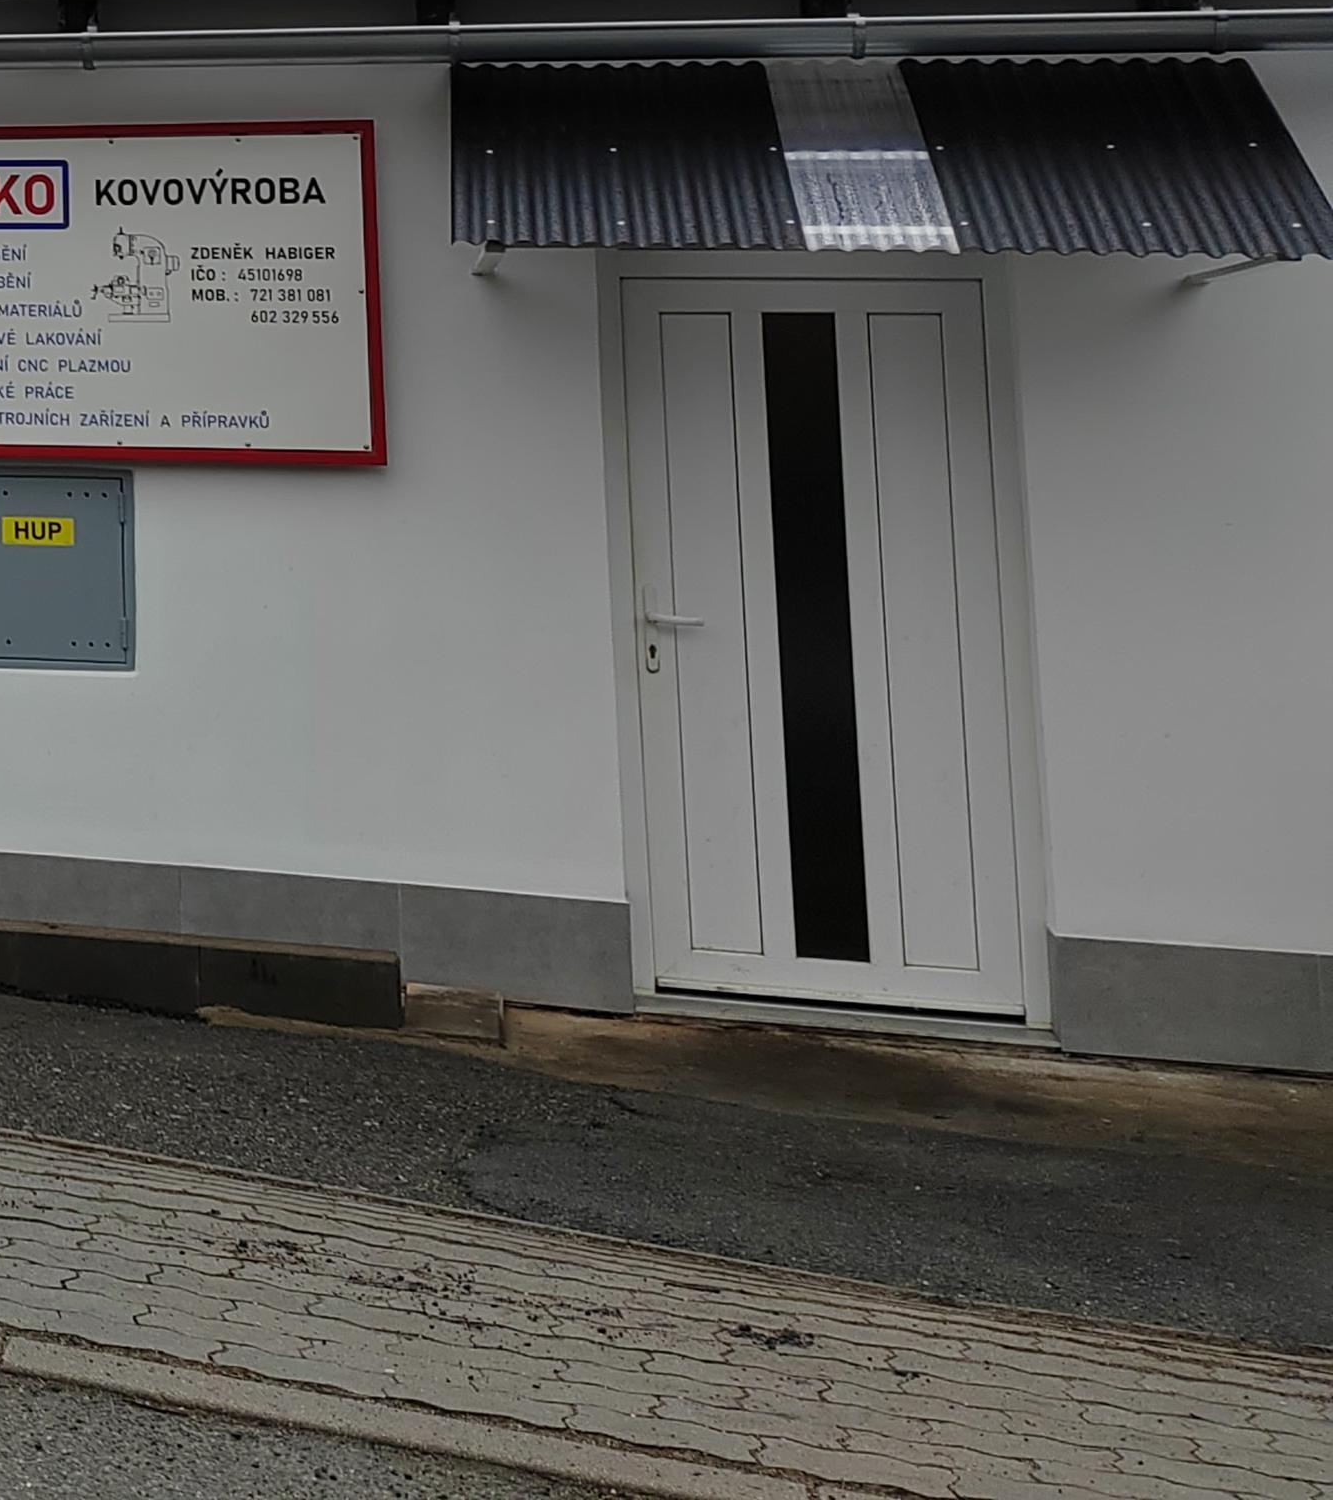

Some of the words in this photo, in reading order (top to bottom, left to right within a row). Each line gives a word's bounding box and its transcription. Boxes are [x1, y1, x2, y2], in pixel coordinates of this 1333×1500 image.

[95, 168, 327, 206] KOVOVÝROBA
[191, 243, 254, 260] ZDENĚK
[265, 247, 335, 260] HABIGER
[191, 265, 216, 281] IČO
[237, 268, 303, 282] 45101698
[191, 288, 230, 303] MOB.
[250, 288, 273, 303] 721
[277, 288, 302, 303] 381
[307, 288, 331, 303] 081
[251, 310, 278, 324] 602
[283, 310, 308, 324] 329
[312, 310, 339, 324] 556
[26, 328, 102, 346] LAKOVÁNÍ
[18, 359, 49, 373] CNC
[58, 359, 131, 373] PLAZMOU
[25, 381, 74, 399] PRÁCE
[79, 409, 150, 428] ZAŘÍZENÍ
[160, 415, 171, 428] A
[181, 410, 269, 429] PŘÍPRAVKŮ
[14, 521, 62, 540] HUP
